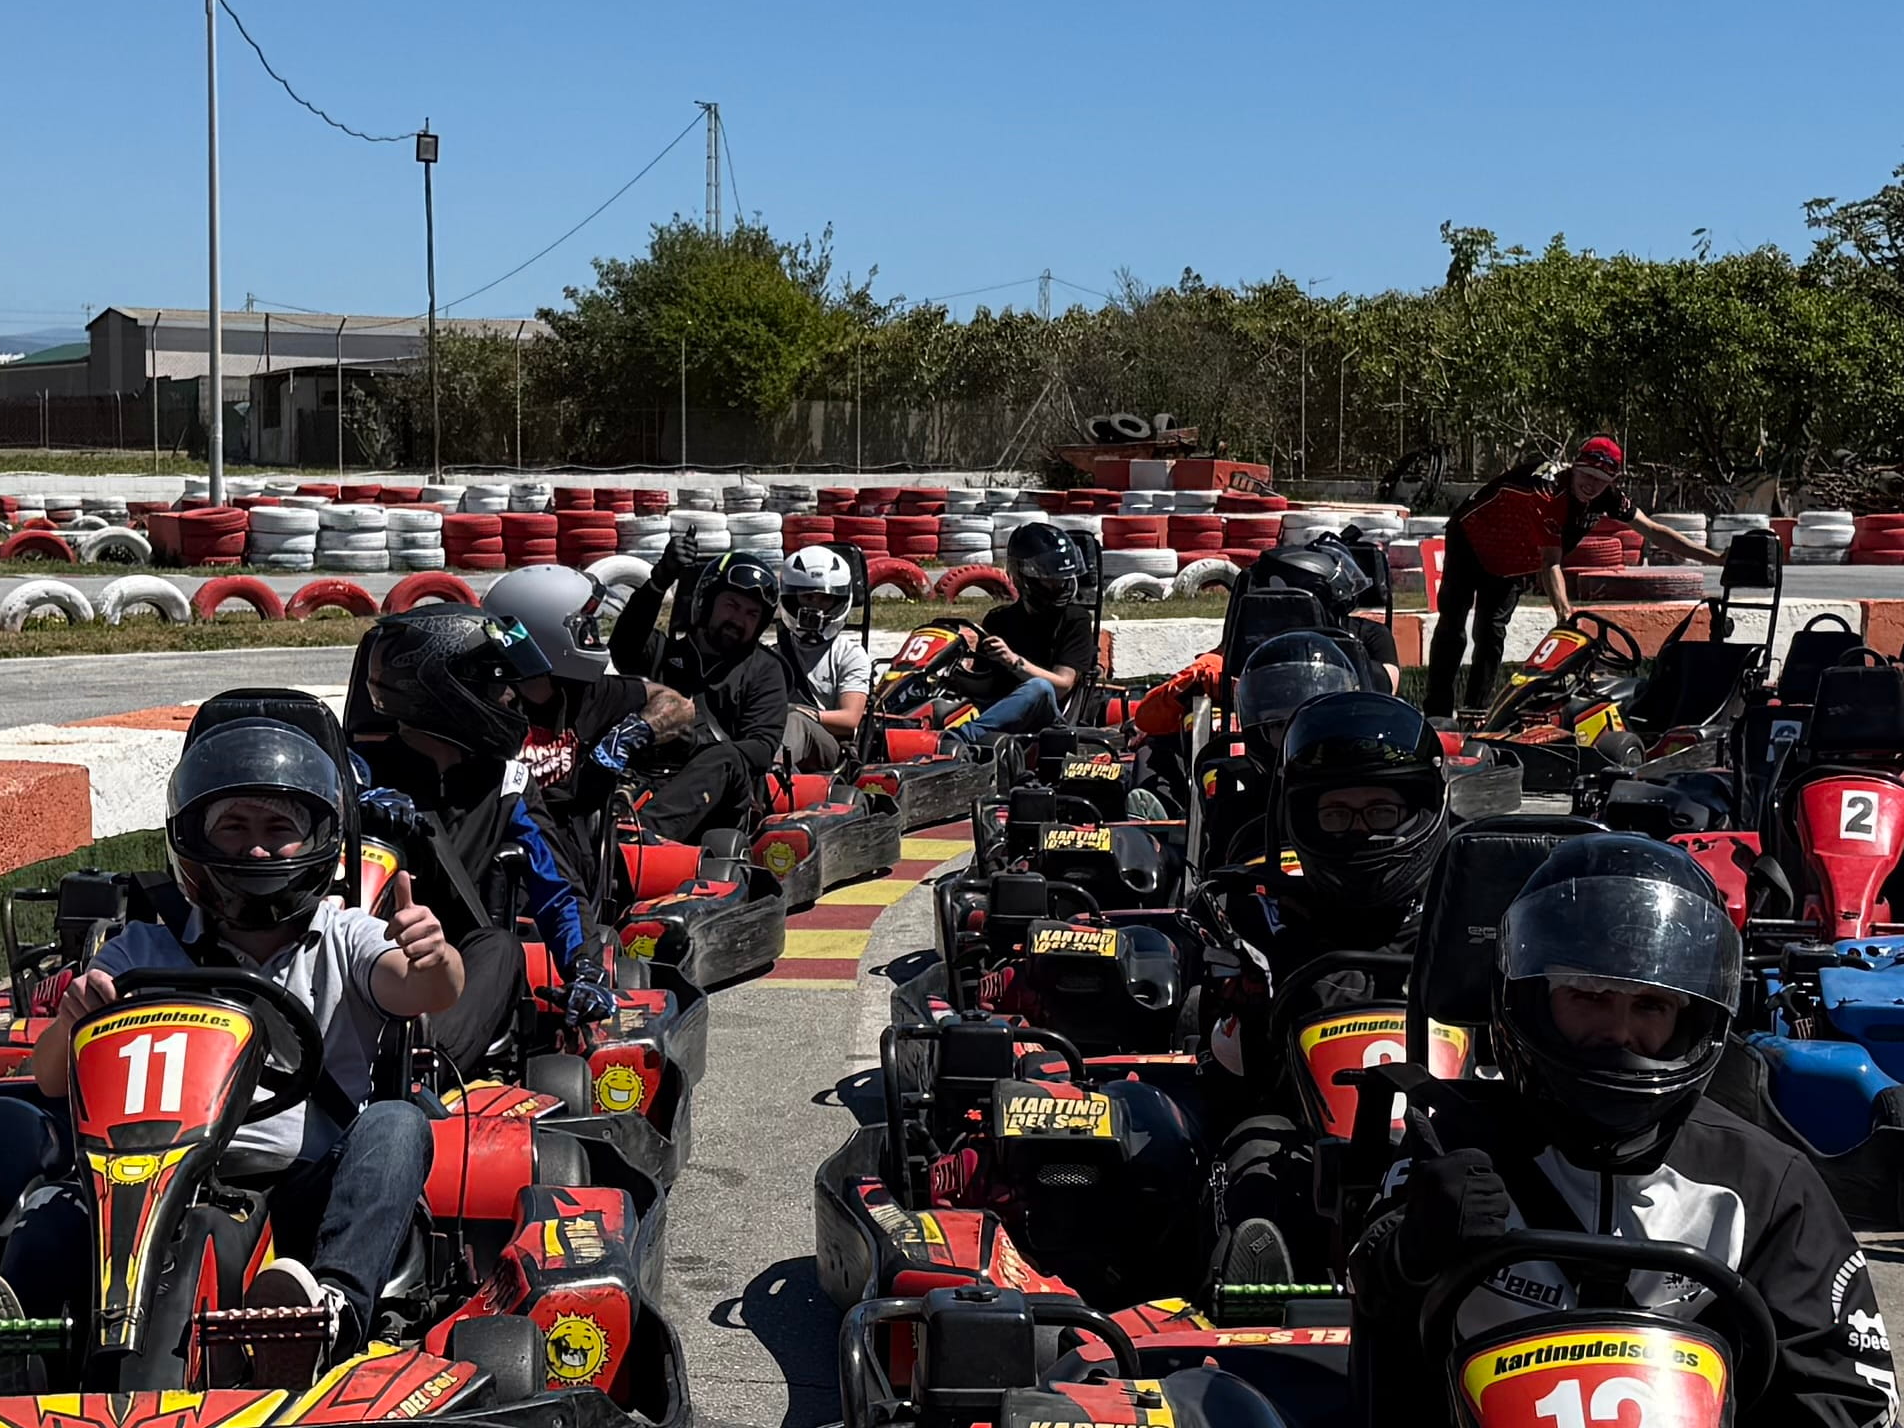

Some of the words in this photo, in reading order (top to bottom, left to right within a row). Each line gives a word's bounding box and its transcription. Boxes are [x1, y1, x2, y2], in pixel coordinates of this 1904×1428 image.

[900, 634, 937, 662] 15
[1533, 637, 1560, 665] 9
[1845, 796, 1874, 835] 2
[118, 1032, 189, 1116] 11
[1008, 1097, 1107, 1115] KARTING
[1848, 1332, 1891, 1353] spee
[399, 1389, 433, 1419] DEL
